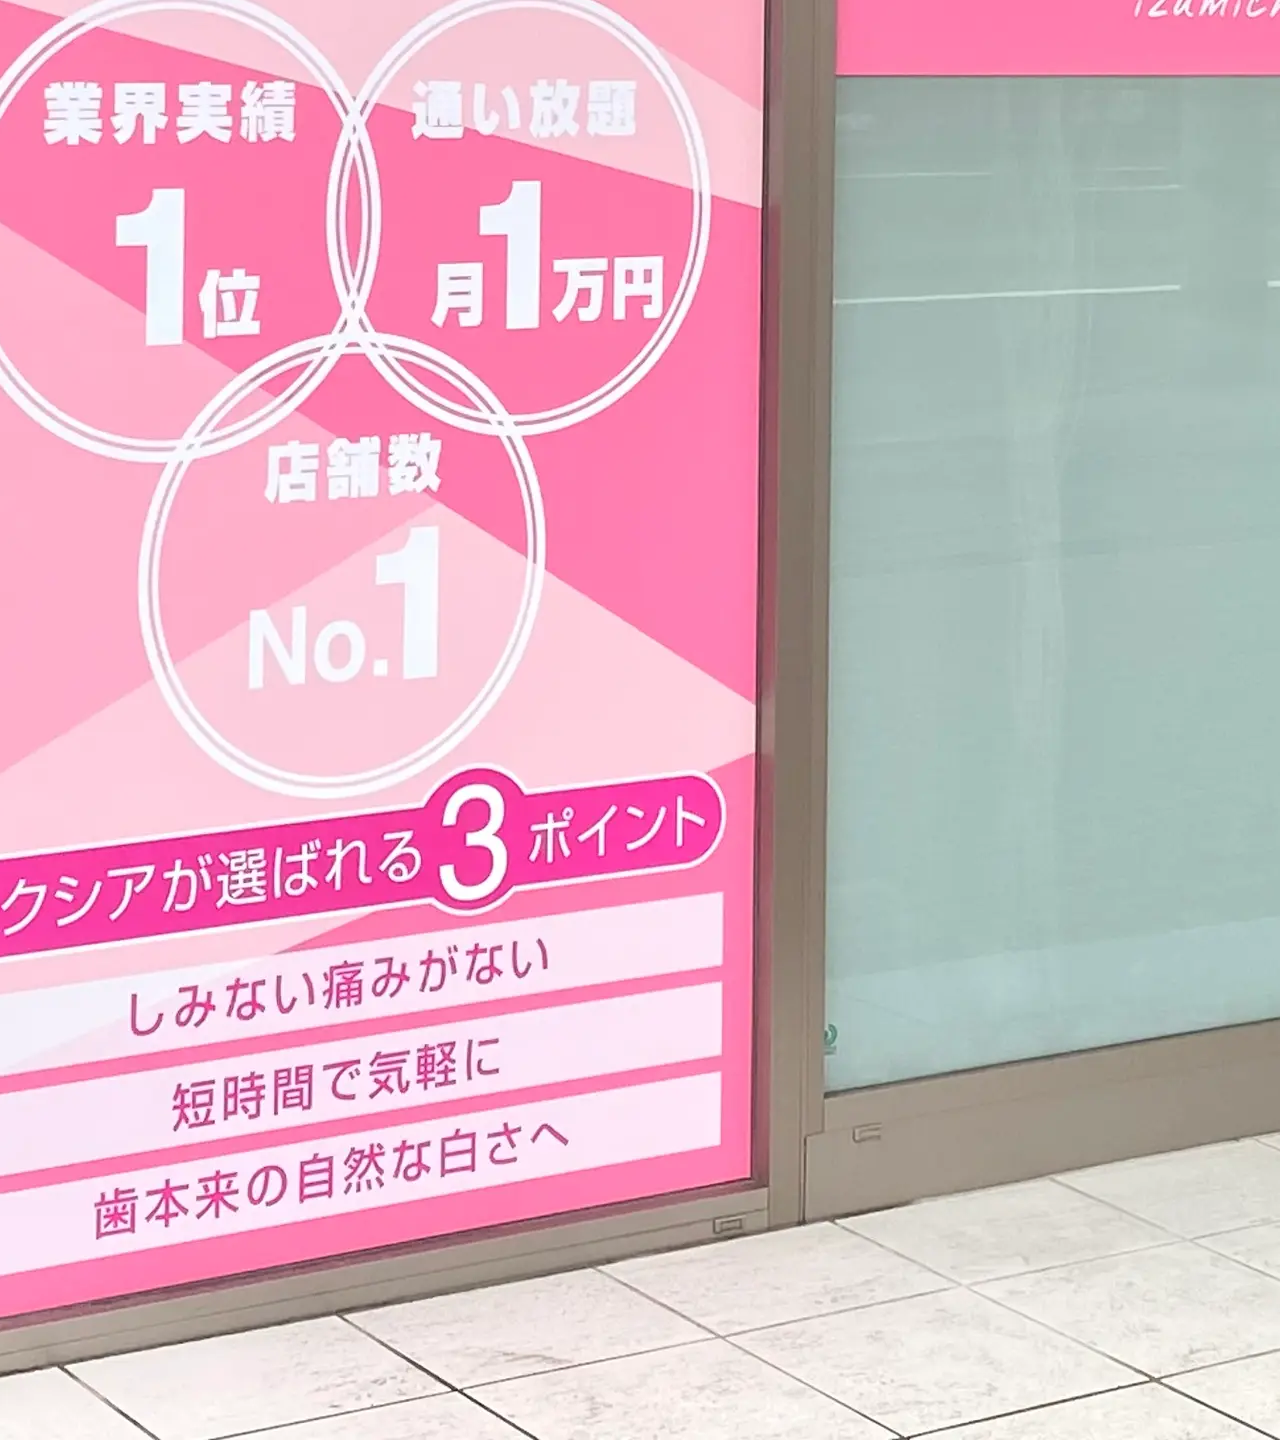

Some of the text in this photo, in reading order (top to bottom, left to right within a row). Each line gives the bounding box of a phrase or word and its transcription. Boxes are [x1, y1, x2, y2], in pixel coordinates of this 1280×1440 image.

[42, 79, 298, 146] 業界実績
[411, 77, 638, 142] 通い放題
[115, 187, 261, 347] 1位
[264, 431, 443, 506] 店舗数
[246, 525, 441, 691] No.1
[128, 937, 550, 1038] しみない痛みがない
[171, 1035, 502, 1133] 短時間で気軽に
[93, 1121, 572, 1241] 歯本来の自然な白さへ
